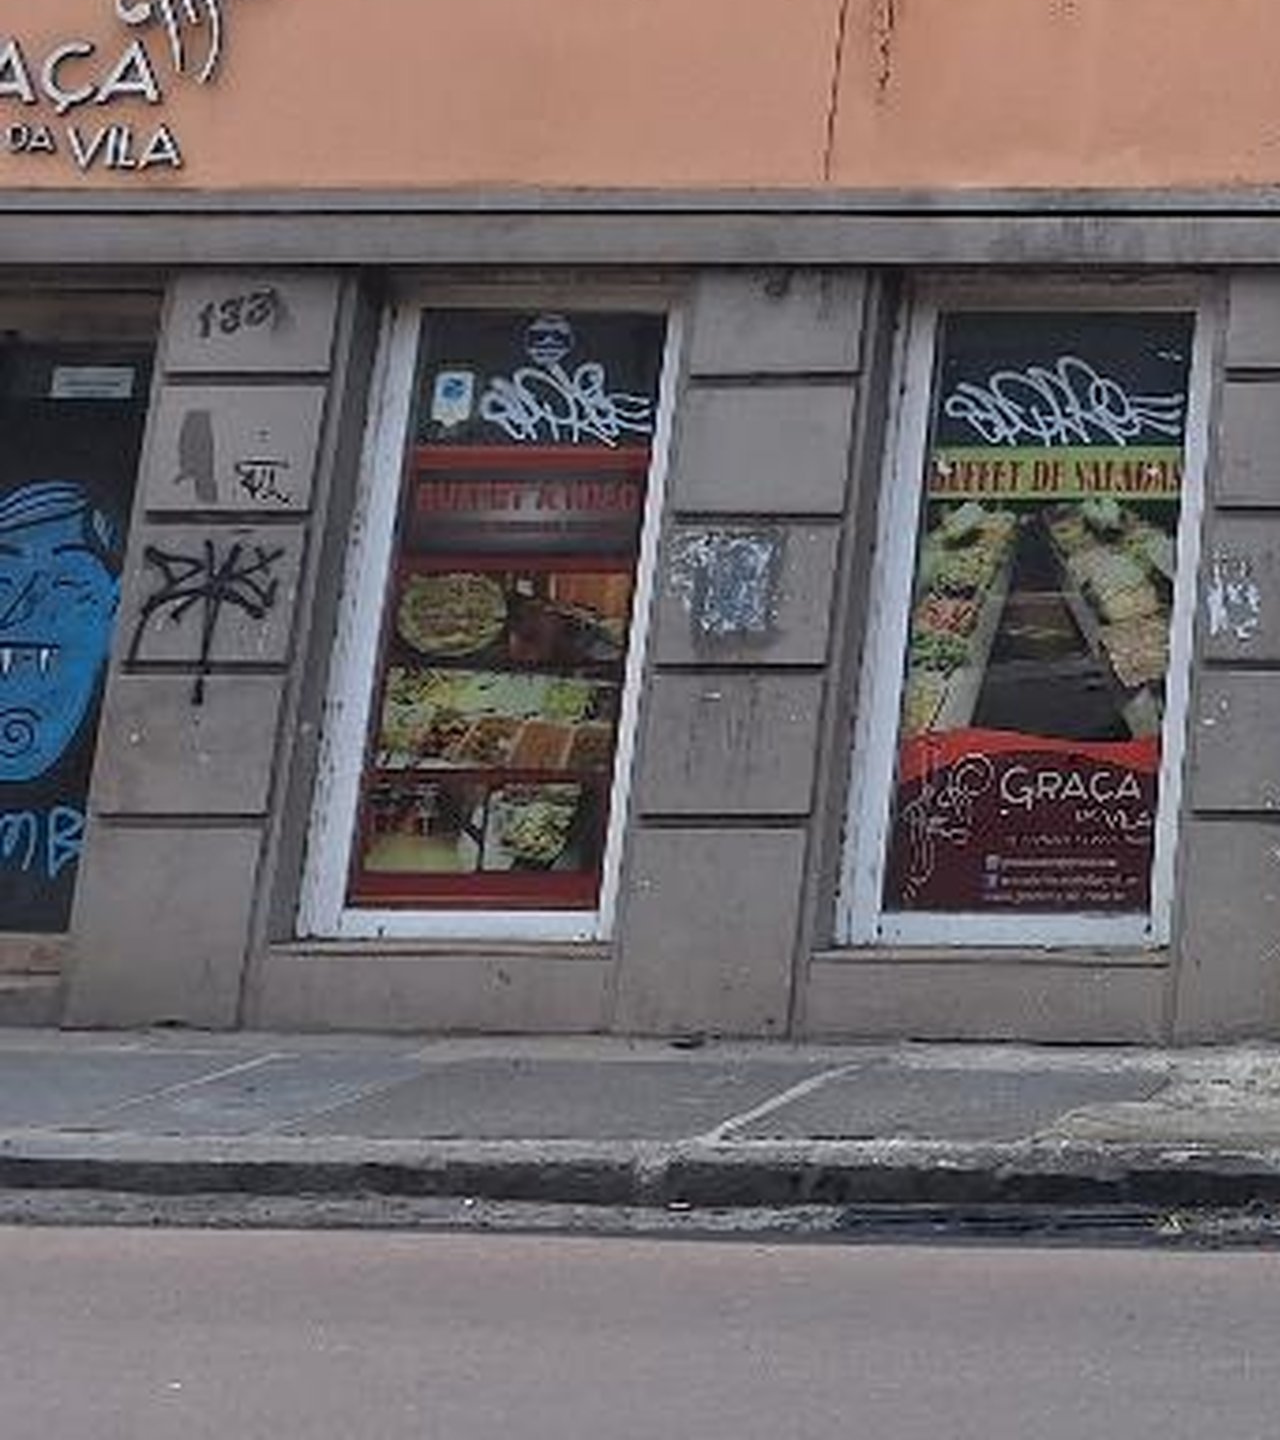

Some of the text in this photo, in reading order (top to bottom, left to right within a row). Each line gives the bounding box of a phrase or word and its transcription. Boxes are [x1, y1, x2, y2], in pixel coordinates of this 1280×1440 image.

[0, 39, 162, 116] AÇA
[67, 122, 183, 171] VILA
[1000, 766, 1142, 810] GRAÇA
